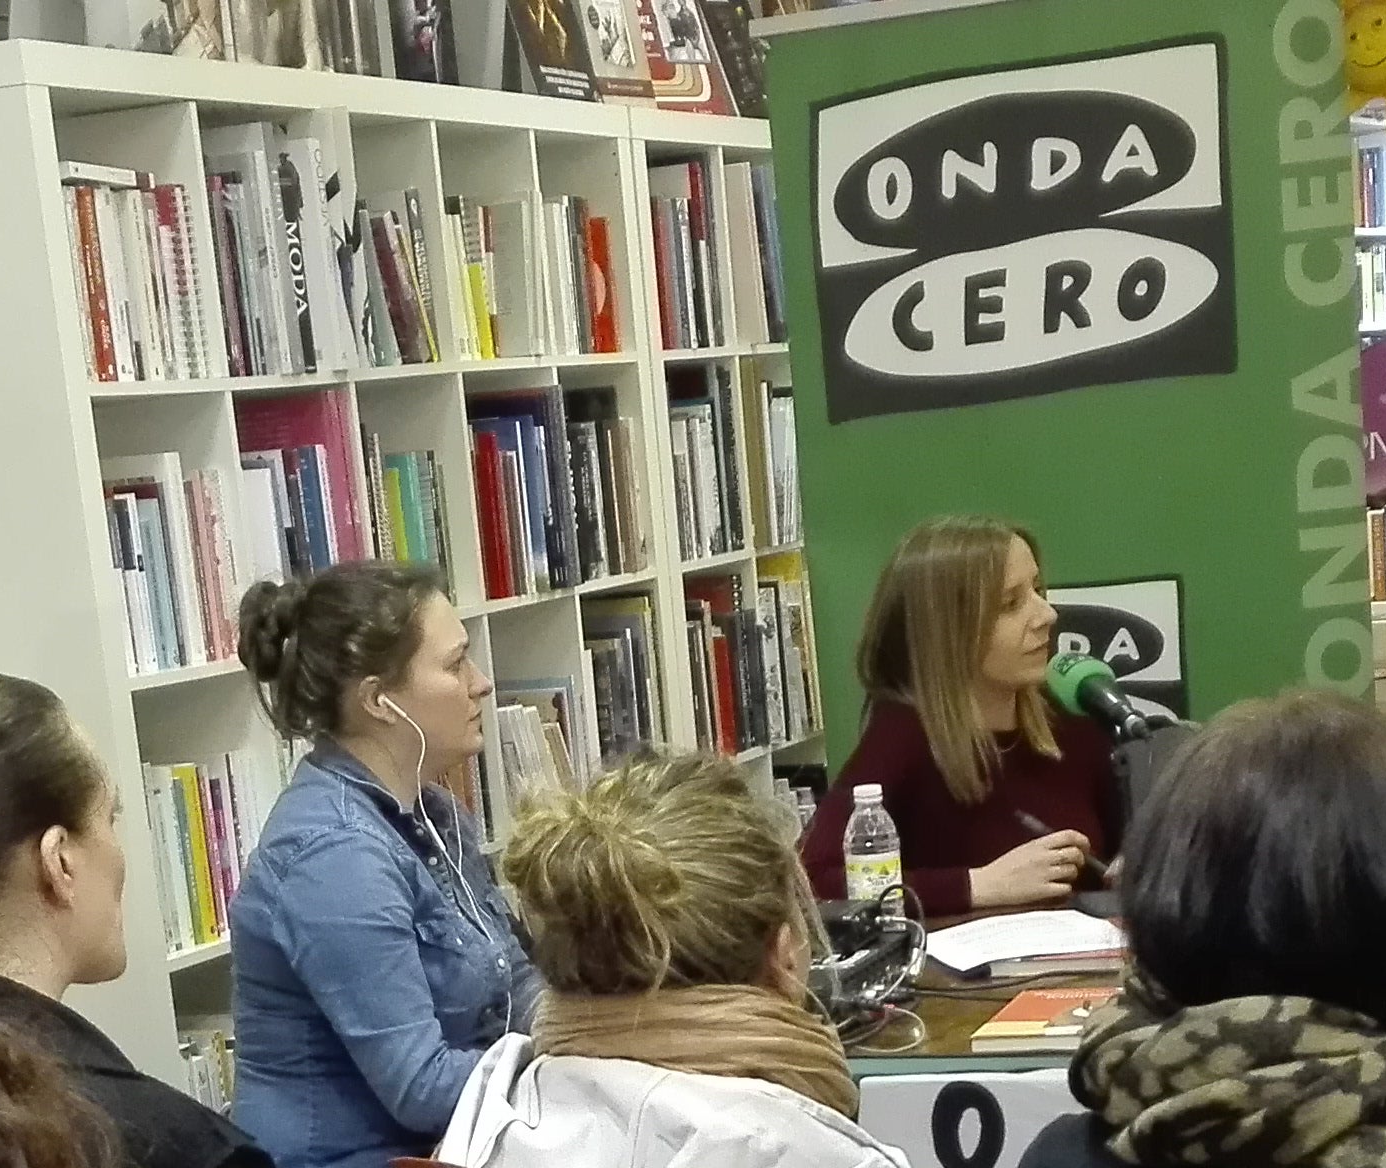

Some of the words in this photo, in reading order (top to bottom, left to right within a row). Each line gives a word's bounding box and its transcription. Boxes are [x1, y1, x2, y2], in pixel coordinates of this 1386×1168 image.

[866, 123, 1158, 220] ONDA
[1273, 0, 1355, 307] CERO
[286, 221, 310, 317] MODA
[891, 255, 1167, 352] CERO
[1292, 337, 1371, 701] ONDA
